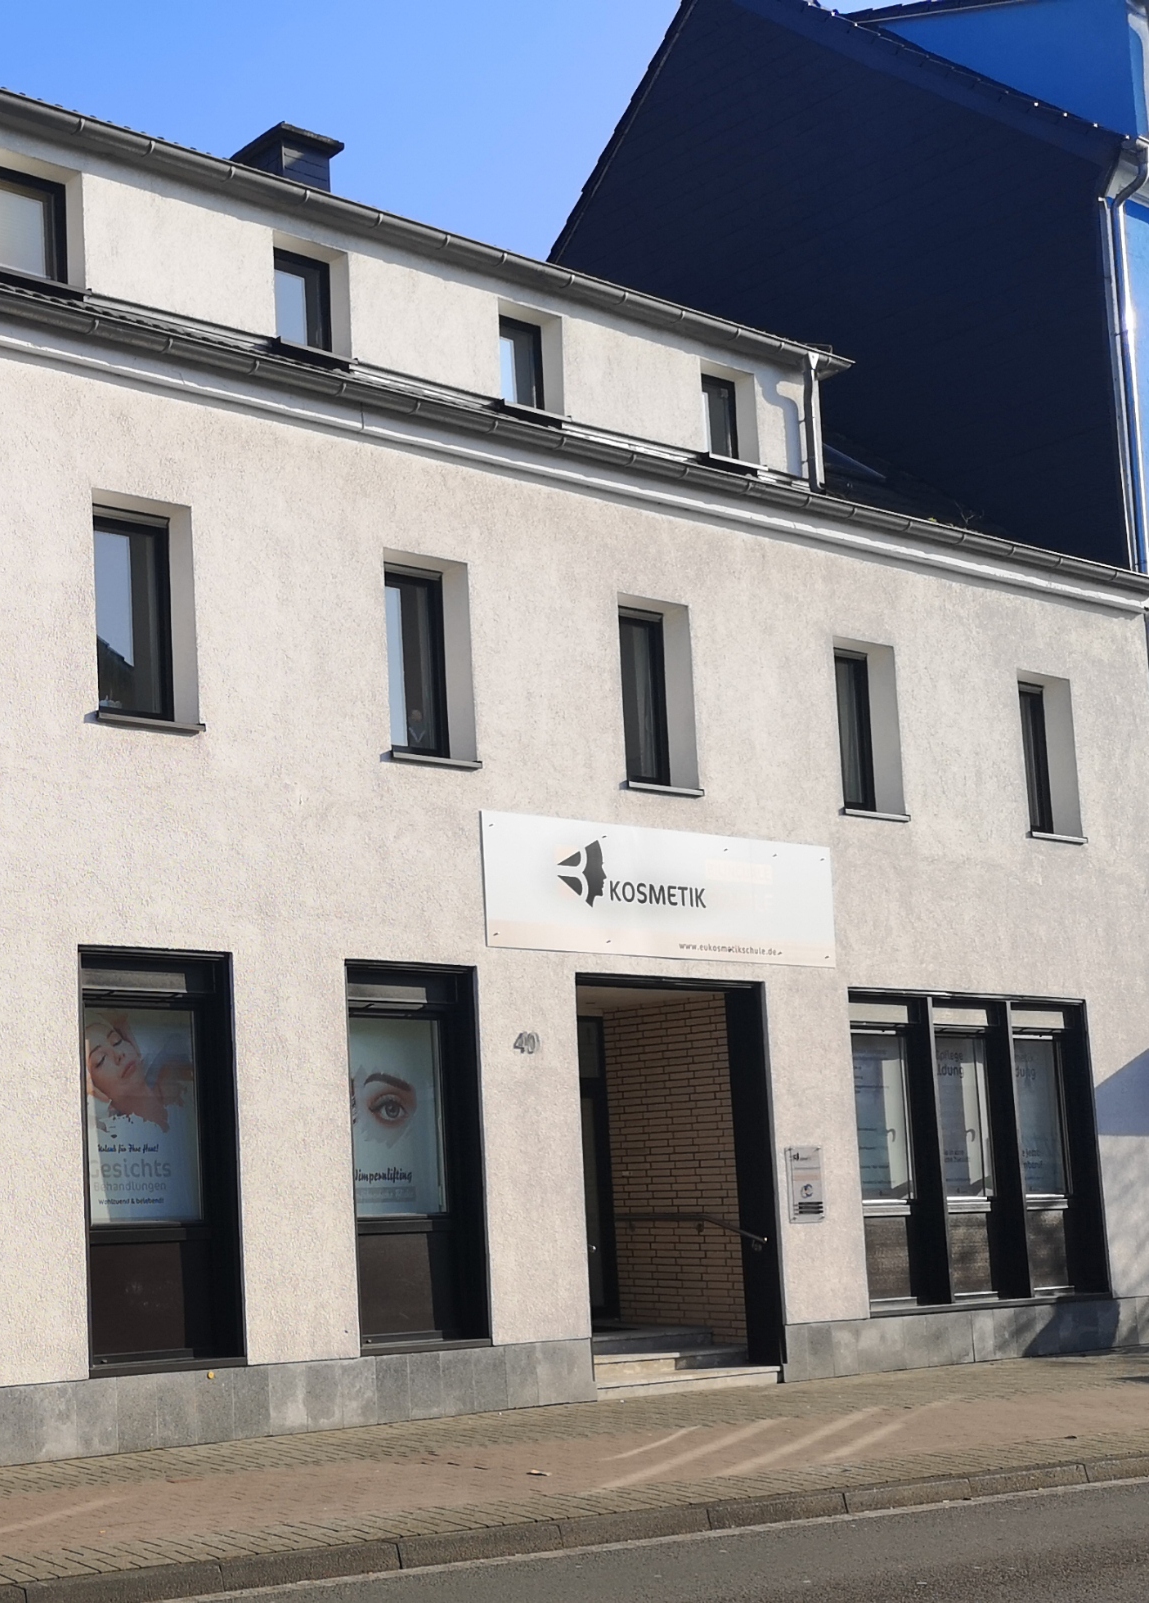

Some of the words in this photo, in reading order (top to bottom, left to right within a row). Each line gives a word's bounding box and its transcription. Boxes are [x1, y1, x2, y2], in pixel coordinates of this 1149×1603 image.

[609, 880, 707, 909] KOSMETIK
[678, 943, 777, 956] www.eukosmetikschule.de
[513, 1031, 541, 1054] 40
[90, 1158, 172, 1178] Gesichts
[93, 1180, 167, 1193] Behandlungen
